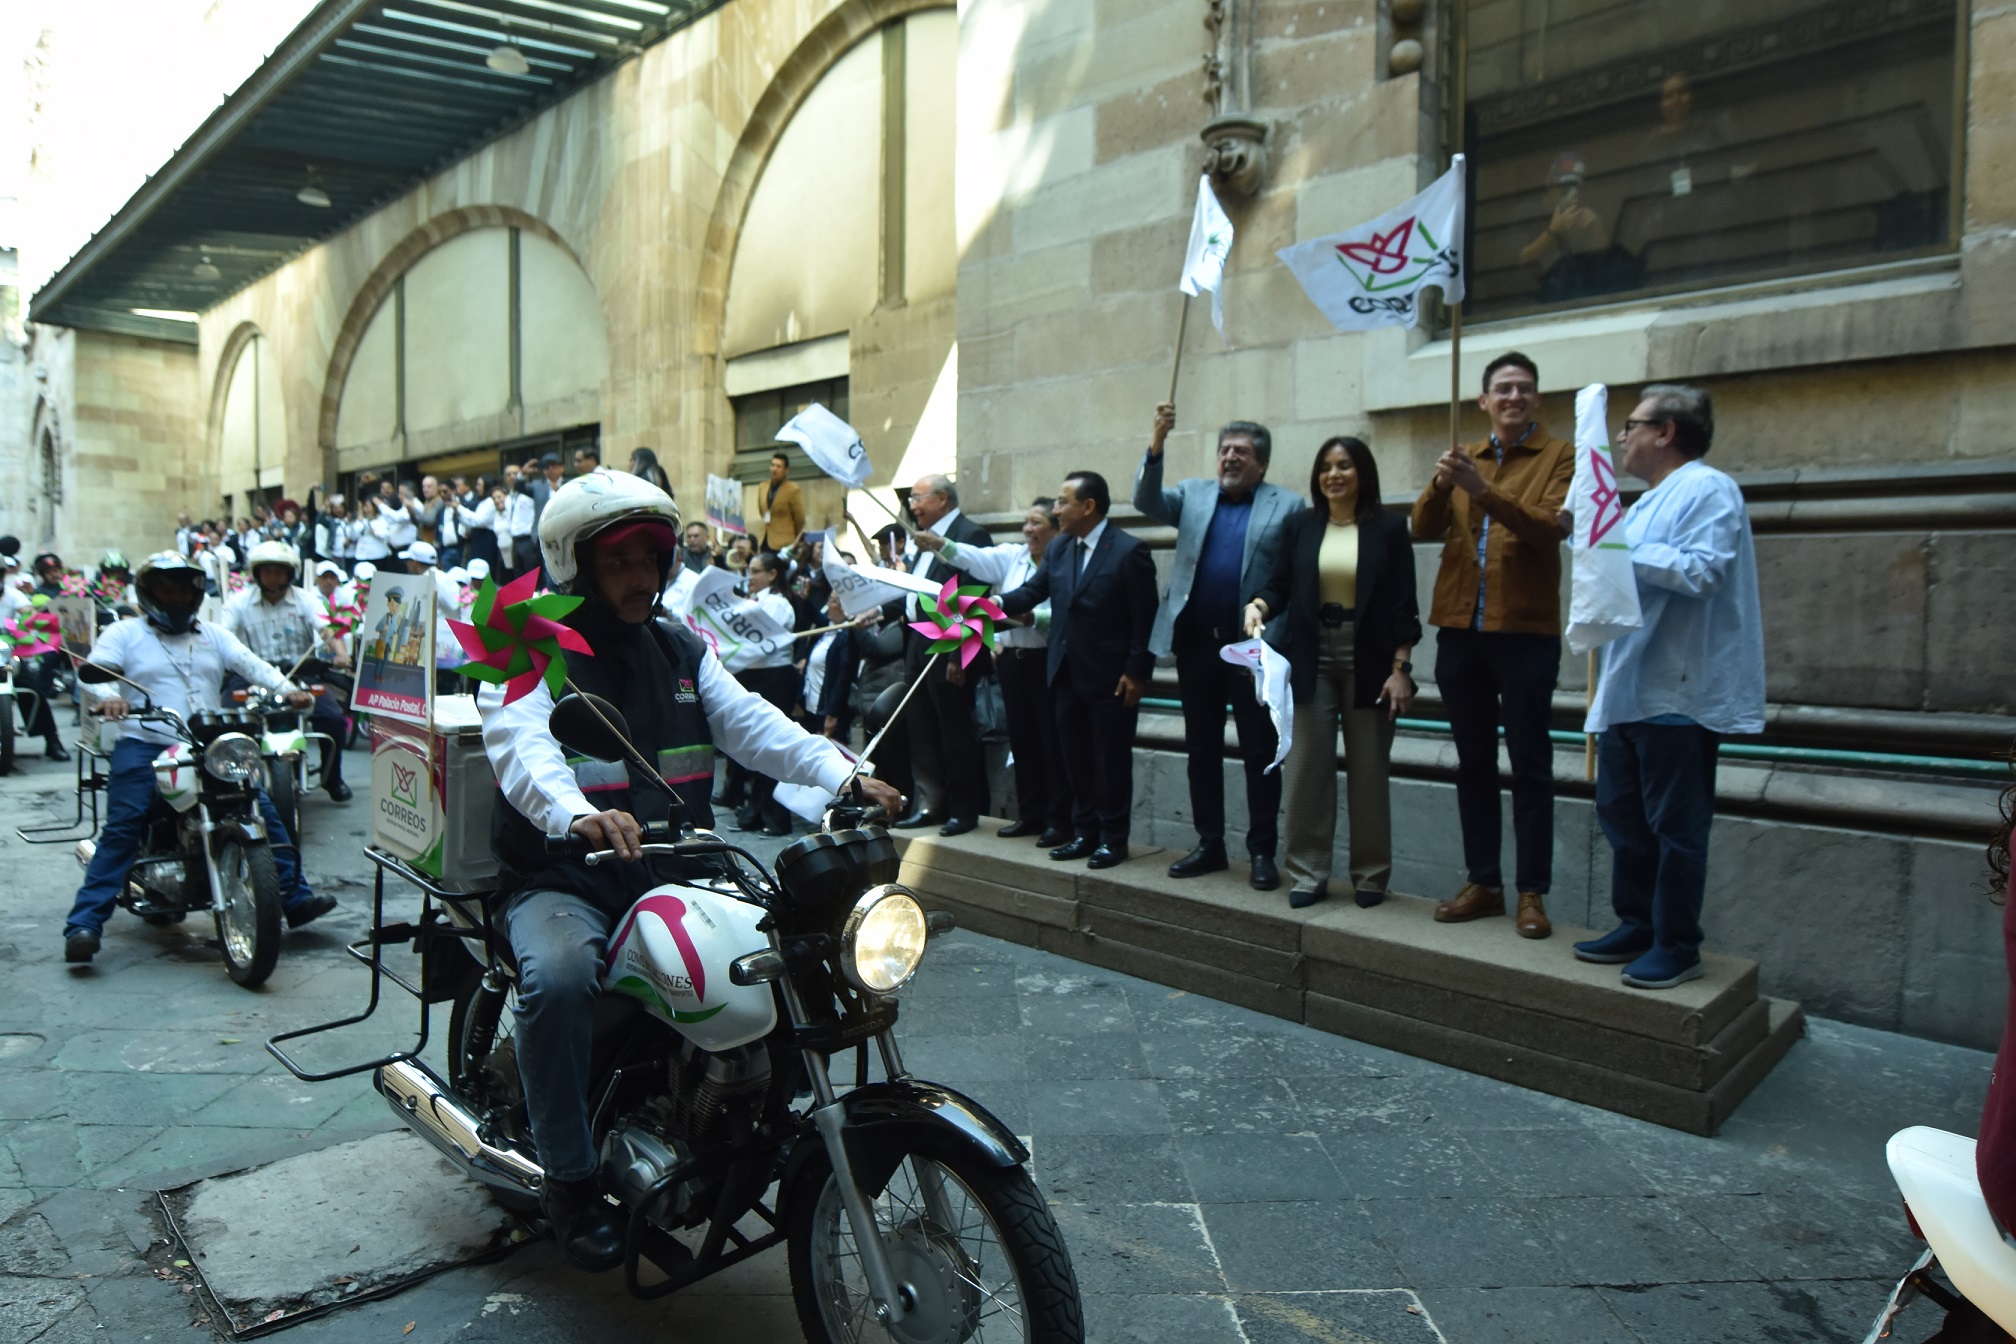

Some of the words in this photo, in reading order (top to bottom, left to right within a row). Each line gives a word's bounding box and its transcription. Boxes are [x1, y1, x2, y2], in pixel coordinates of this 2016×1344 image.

[368, 694, 378, 705] AP
[378, 696, 399, 710] Palacio
[381, 798, 426, 832] CORREOS
[842, 1018, 885, 1038] HONDA
